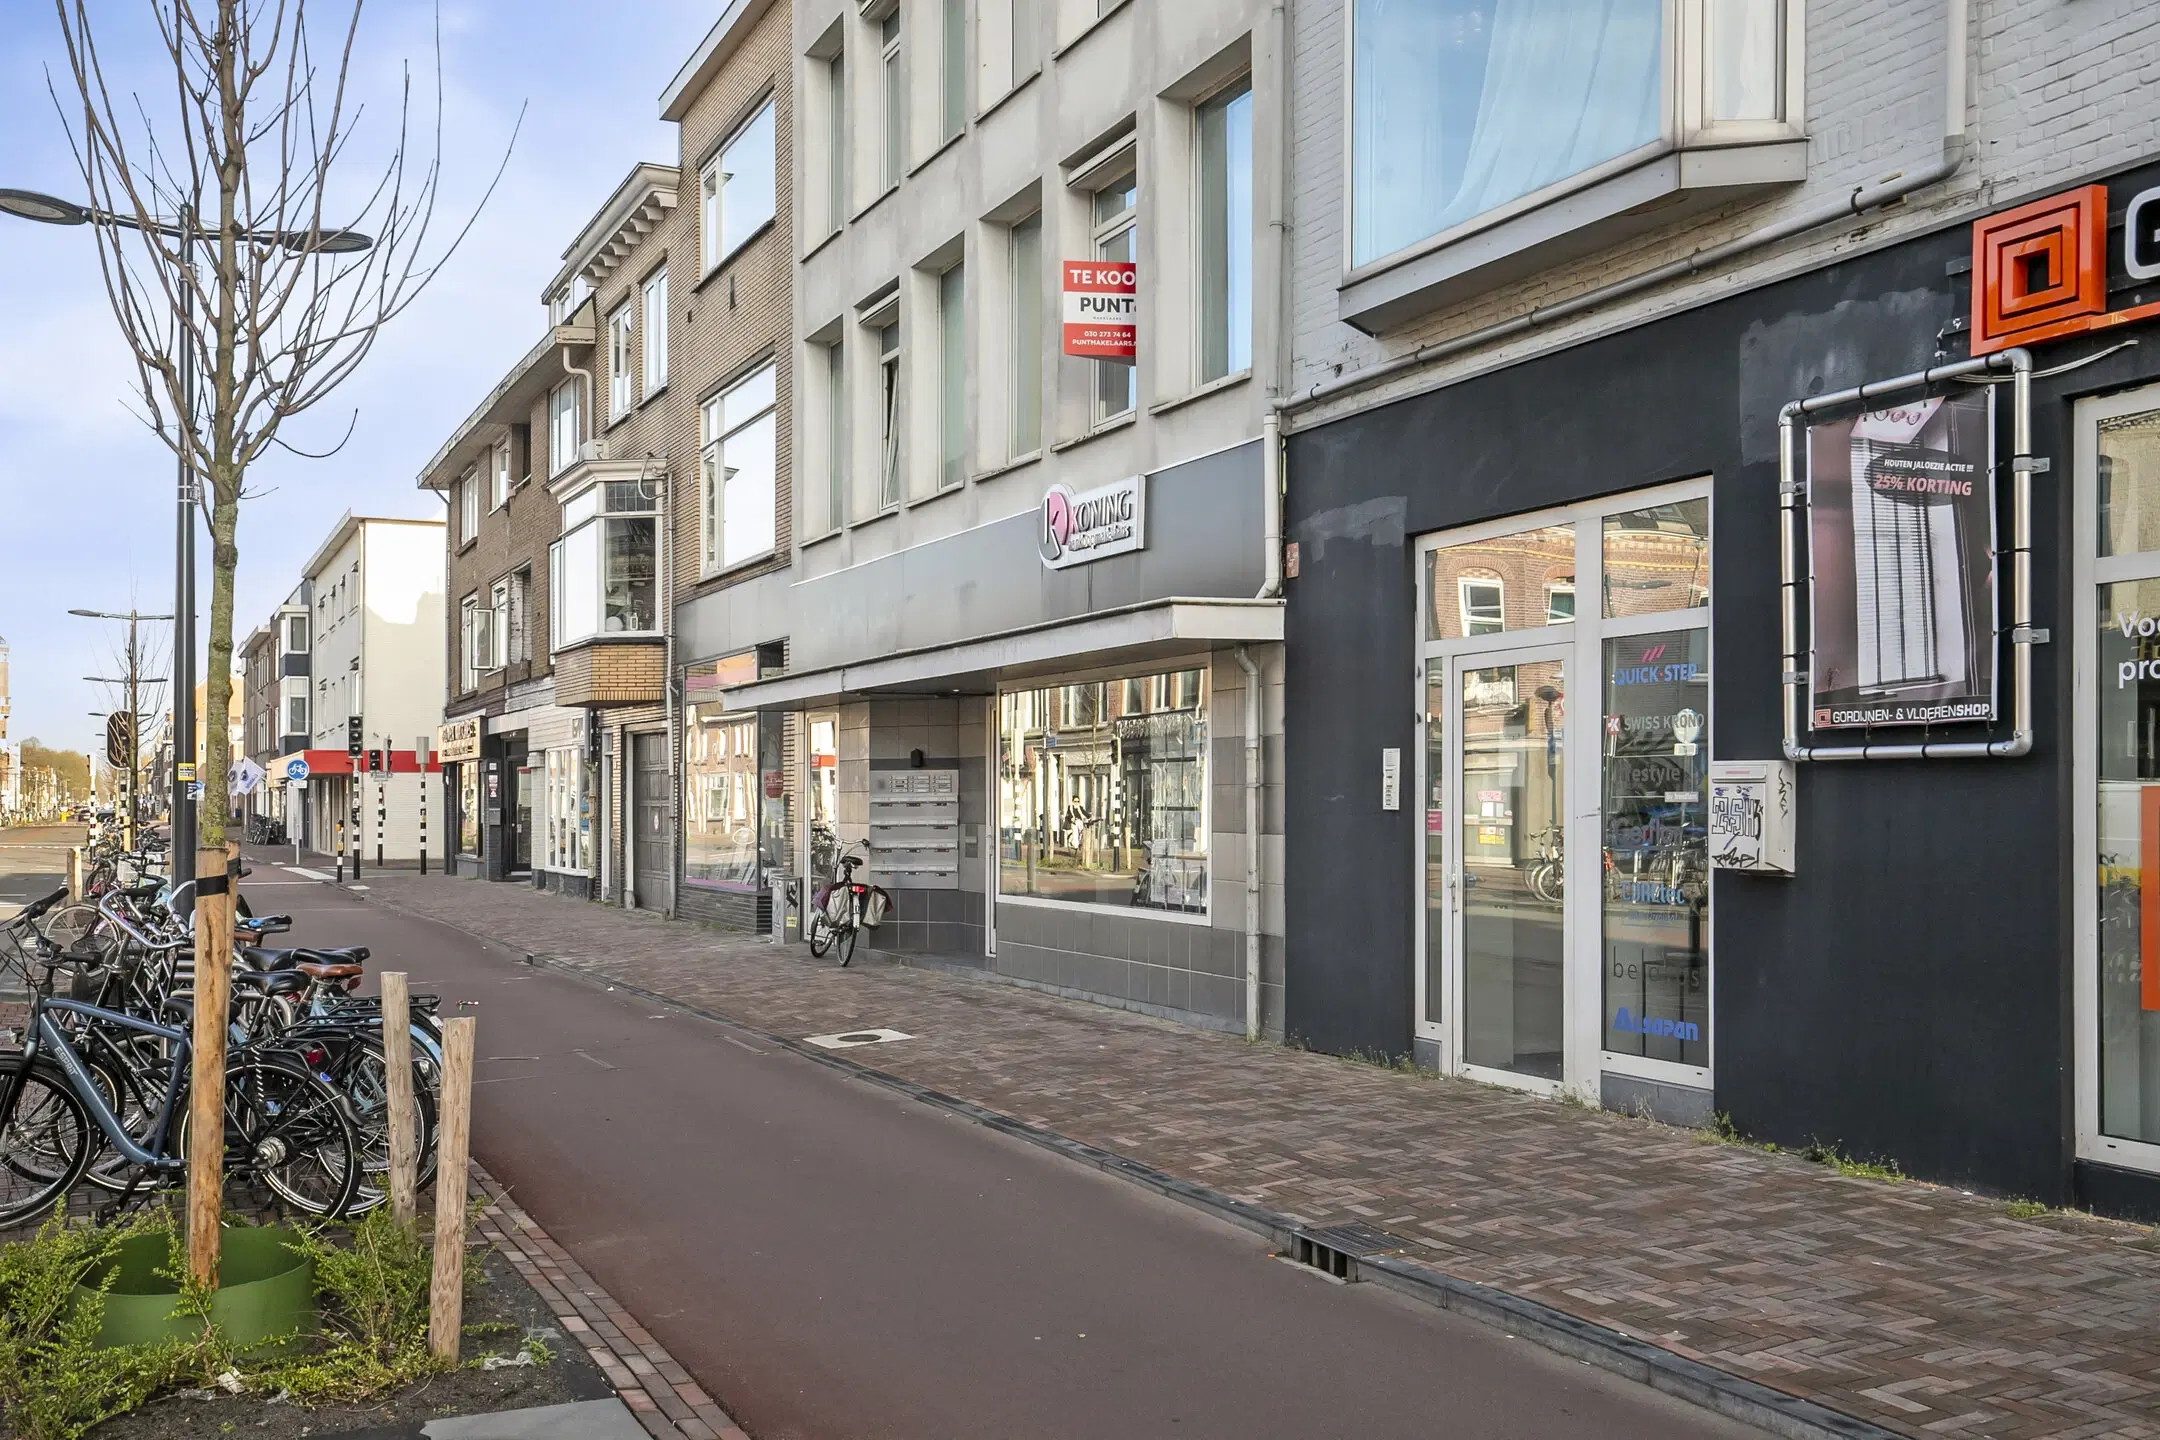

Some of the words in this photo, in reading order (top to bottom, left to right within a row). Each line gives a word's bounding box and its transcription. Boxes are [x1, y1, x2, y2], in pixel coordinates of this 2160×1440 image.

[1070, 269, 1092, 284] TE
[1080, 297, 1134, 313] PUNT
[1884, 459, 1913, 469] HOUTEN
[1913, 461, 1945, 471] JALOEZIE
[1945, 464, 1966, 472] ACTIE
[1874, 473, 1903, 489] 25%
[1907, 477, 1972, 496] KORTING
[1070, 489, 1132, 534] KONING
[2117, 611, 2160, 638] Vo
[1624, 715, 1660, 731] SWISS
[1663, 713, 1705, 729] KRONO
[1833, 708, 1893, 723] GORDIJNEN-
[1895, 707, 1904, 720] &
[1906, 703, 1990, 720] VLOERENSHOP
[54, 1046, 79, 1075] ESPRIT
